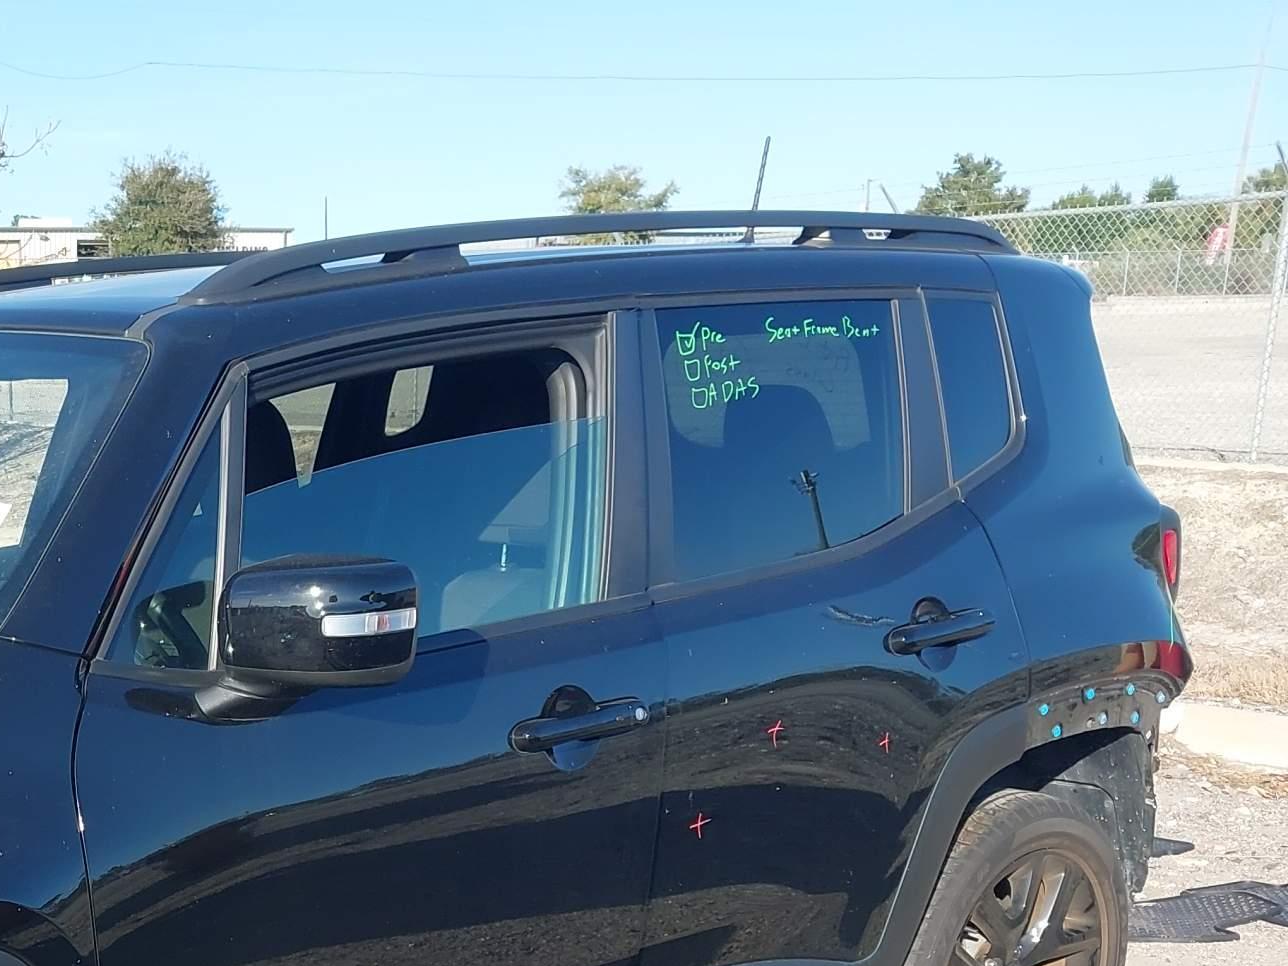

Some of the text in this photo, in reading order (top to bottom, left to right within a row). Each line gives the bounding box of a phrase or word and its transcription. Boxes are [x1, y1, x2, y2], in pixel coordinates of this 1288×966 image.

[765, 317, 801, 343] Seat
[842, 315, 880, 338] Bent
[709, 376, 760, 407] ADAS
